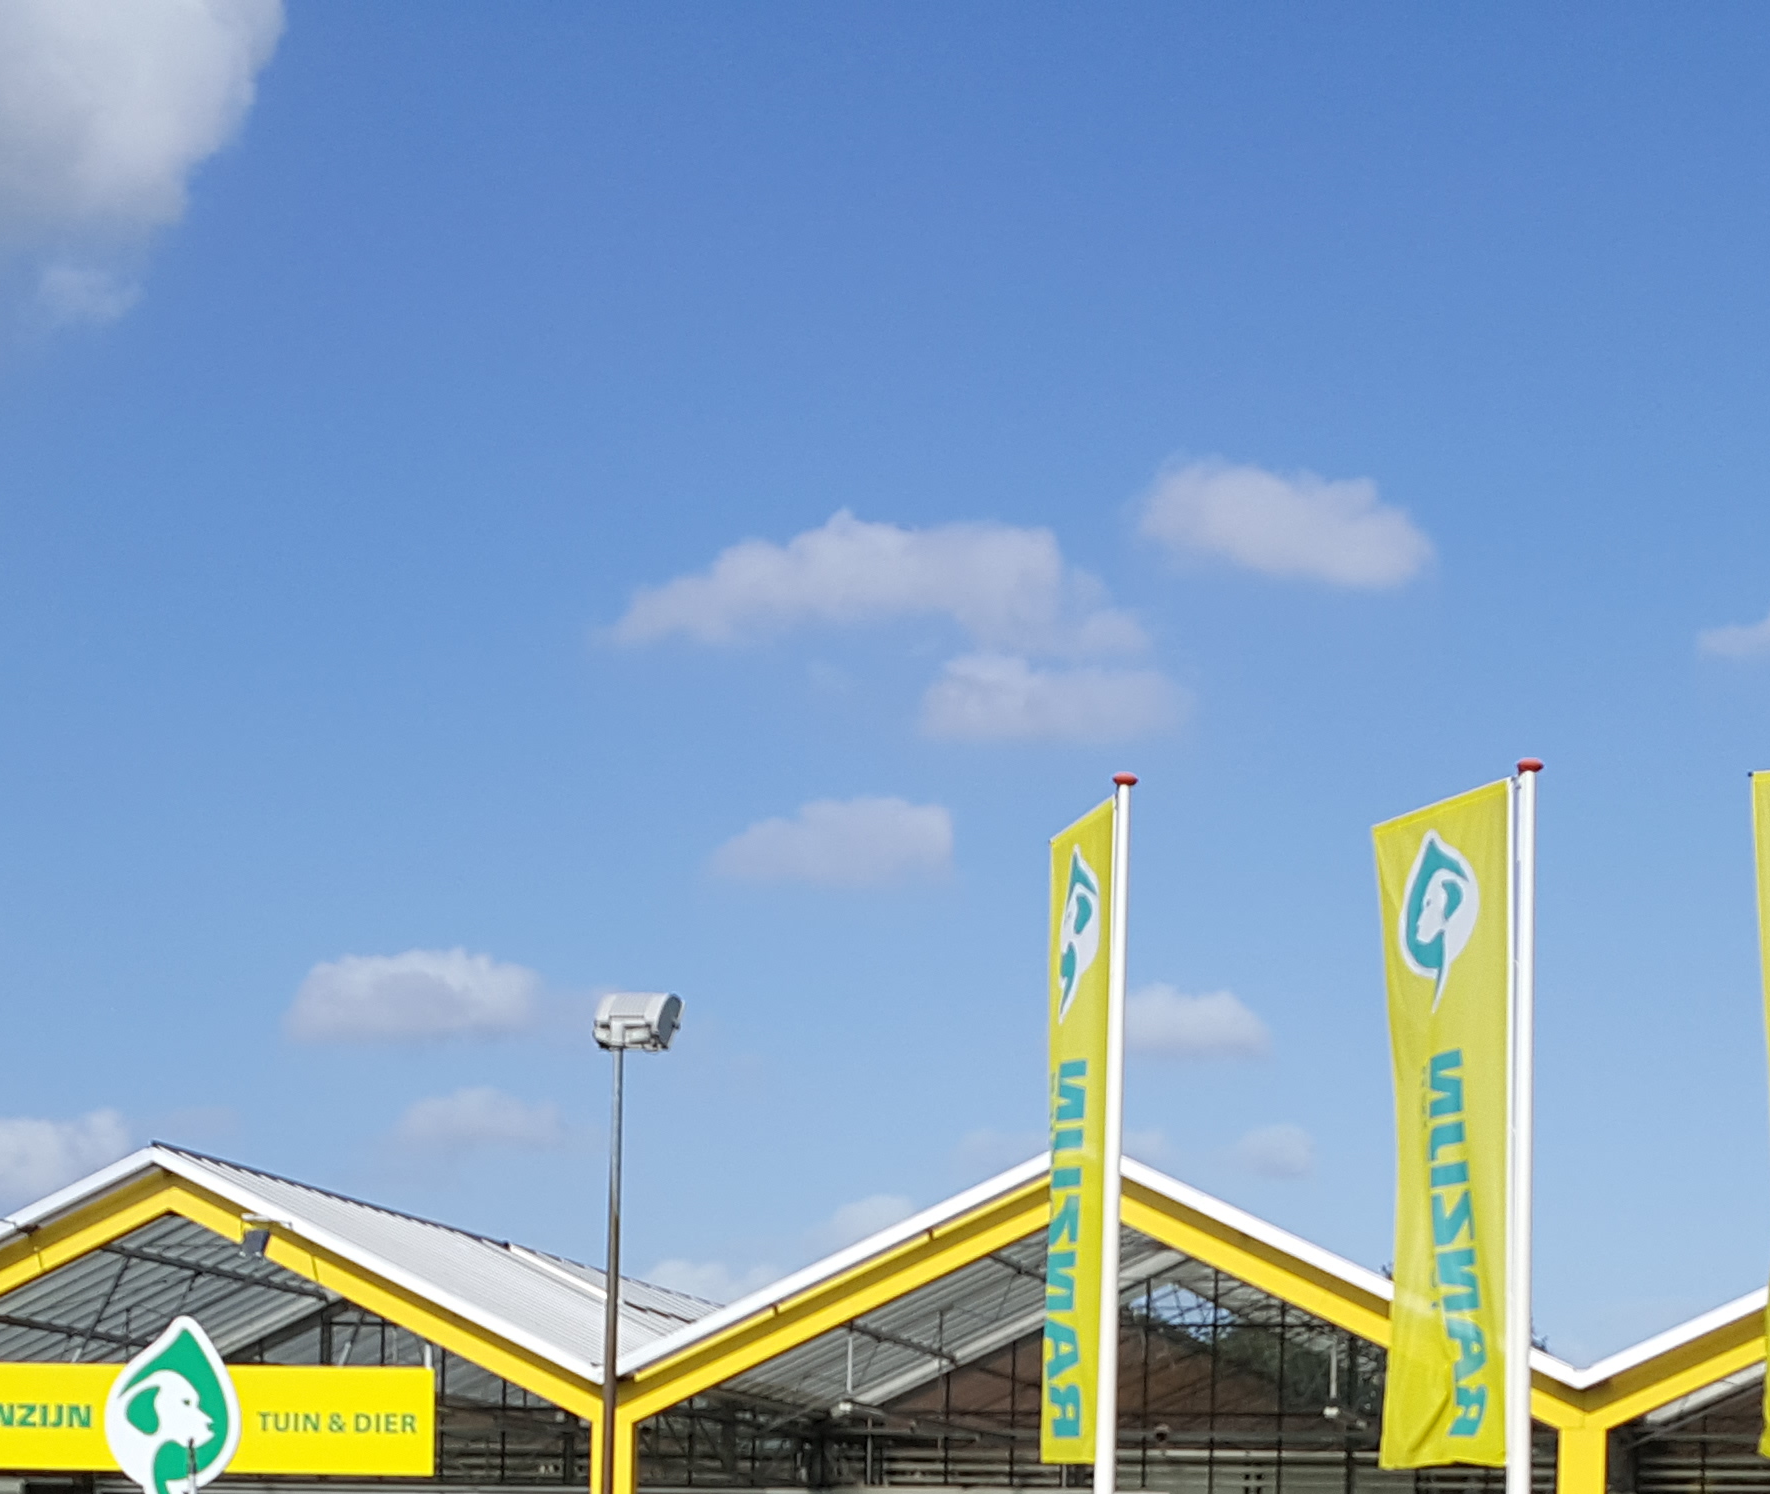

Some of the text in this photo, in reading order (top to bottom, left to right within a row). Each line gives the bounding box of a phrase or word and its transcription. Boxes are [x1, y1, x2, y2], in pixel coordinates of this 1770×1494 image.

[258, 1412, 417, 1433] TUIN & DIER
